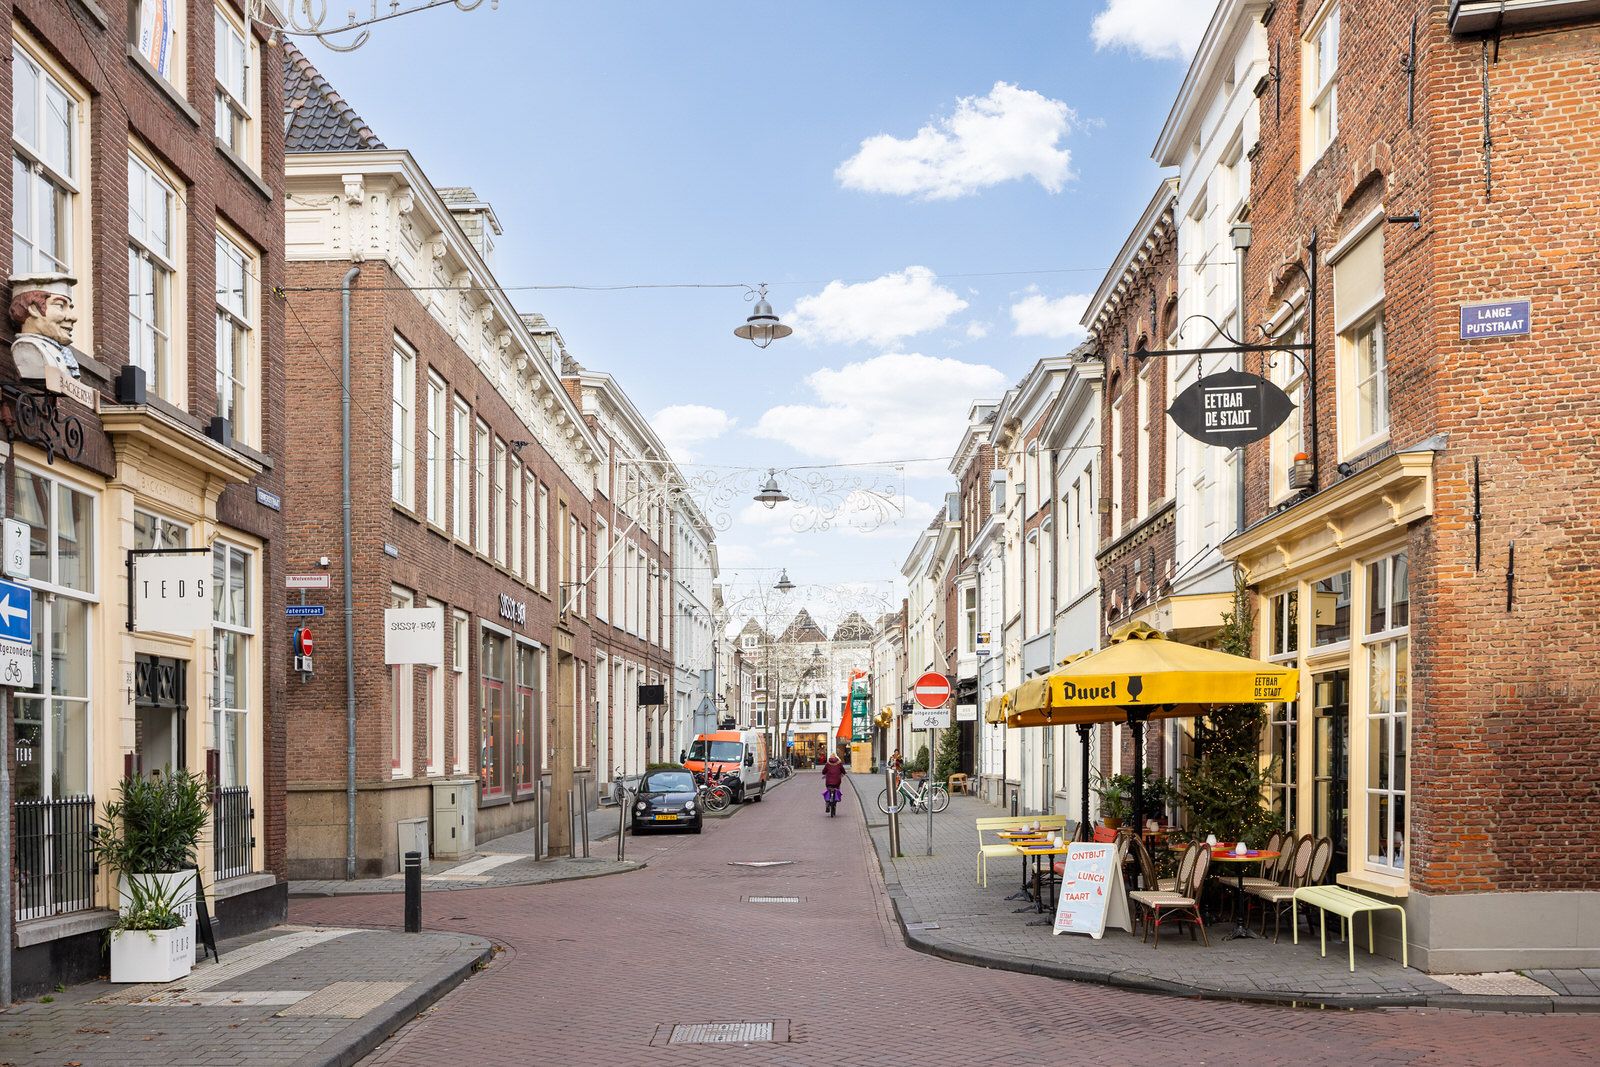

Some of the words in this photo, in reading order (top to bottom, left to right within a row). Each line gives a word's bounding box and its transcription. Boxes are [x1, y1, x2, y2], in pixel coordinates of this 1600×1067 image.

[1478, 307, 1512, 319] LANGE
[1467, 320, 1524, 334] PUTSTRAAT
[1205, 392, 1242, 408] EETBAR
[1205, 411, 1218, 426] DE
[1220, 410, 1251, 425] STADT
[15, 555, 23, 566] 53
[143, 579, 204, 599] TEDS
[391, 621, 436, 632] SISSY-BOY
[1255, 677, 1278, 686] EETBAR
[1063, 681, 1116, 700] Duvel
[1254, 688, 1262, 696] DE
[1263, 687, 1281, 697] STADT
[1072, 850, 1106, 860] ONTBIJT
[1078, 872, 1105, 882] LUNCH
